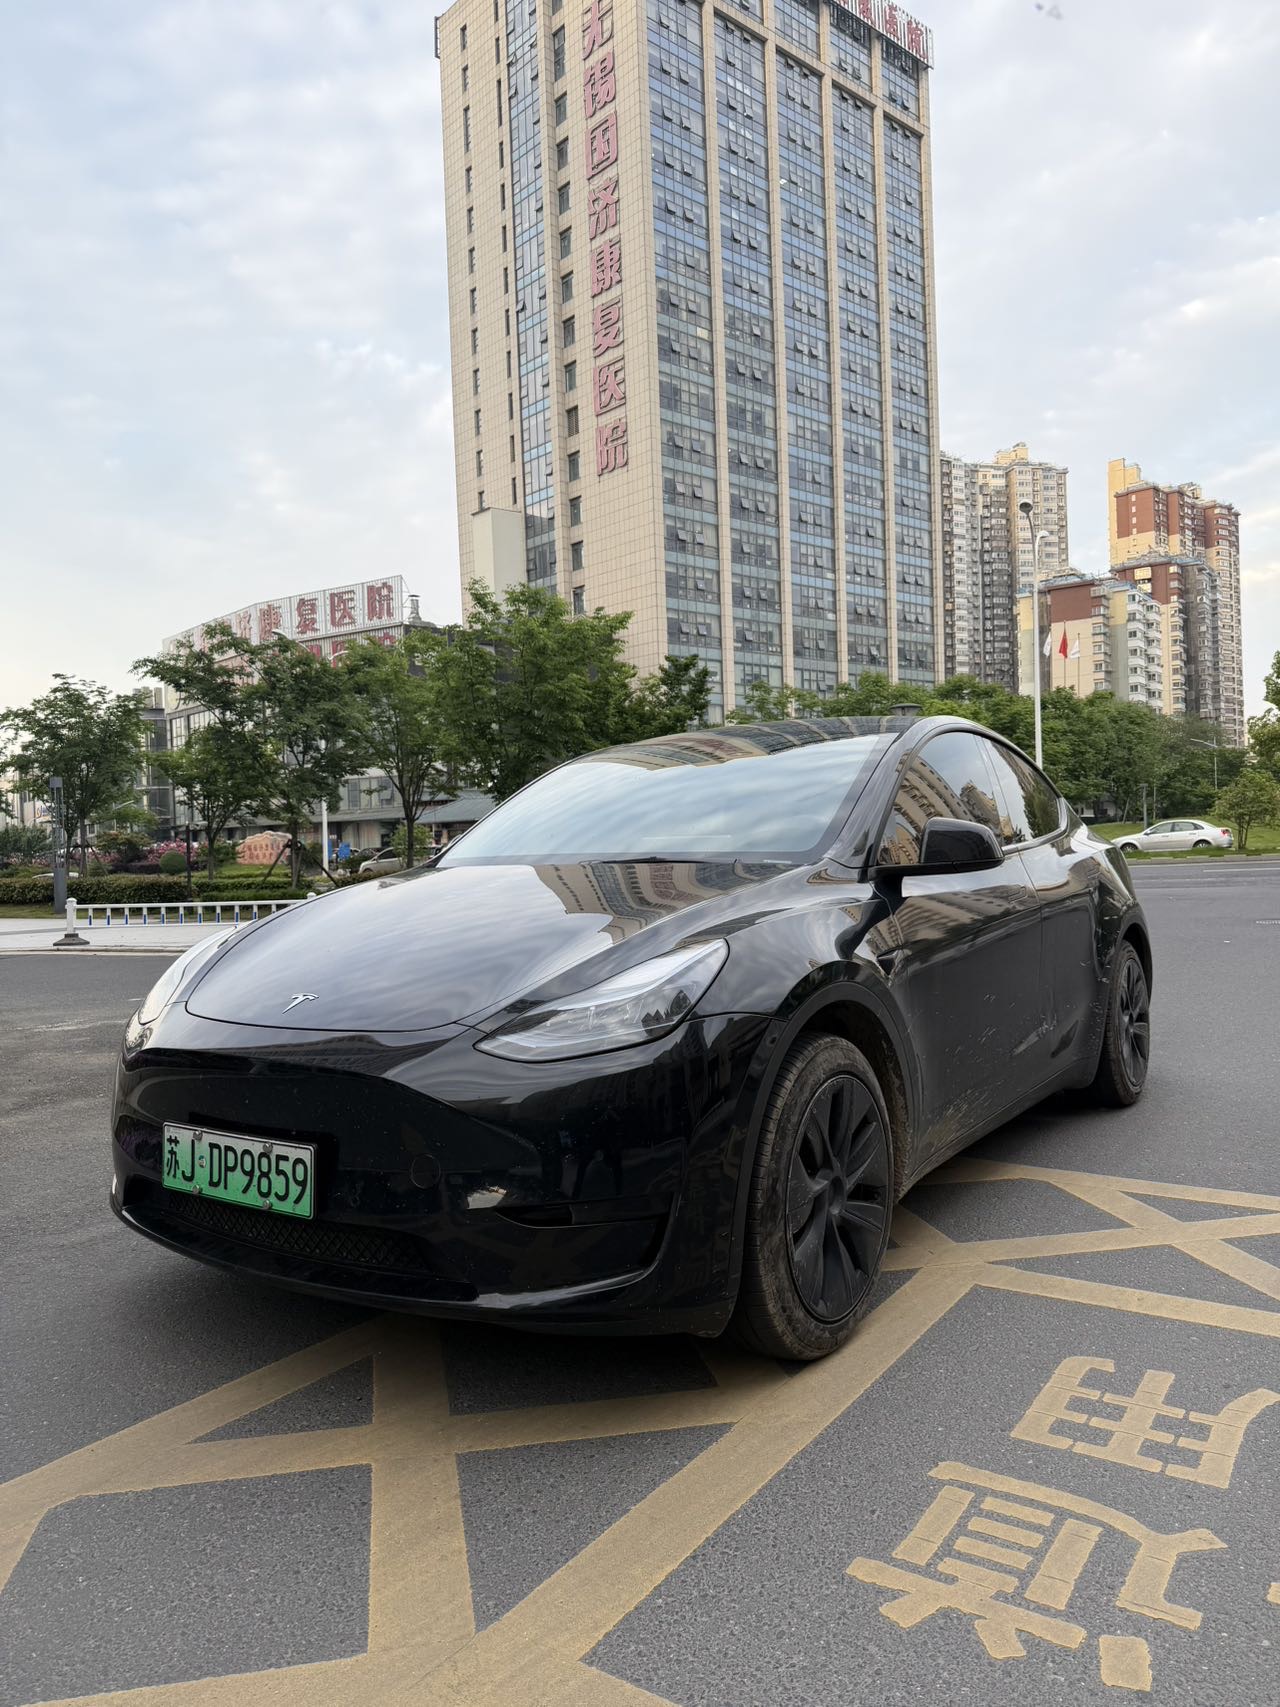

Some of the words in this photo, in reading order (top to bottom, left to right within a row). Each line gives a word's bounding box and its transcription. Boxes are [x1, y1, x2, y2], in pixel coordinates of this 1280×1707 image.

[582, 0, 629, 477] 无锡国济康复医院
[1010, 1355, 1280, 1489] 用
